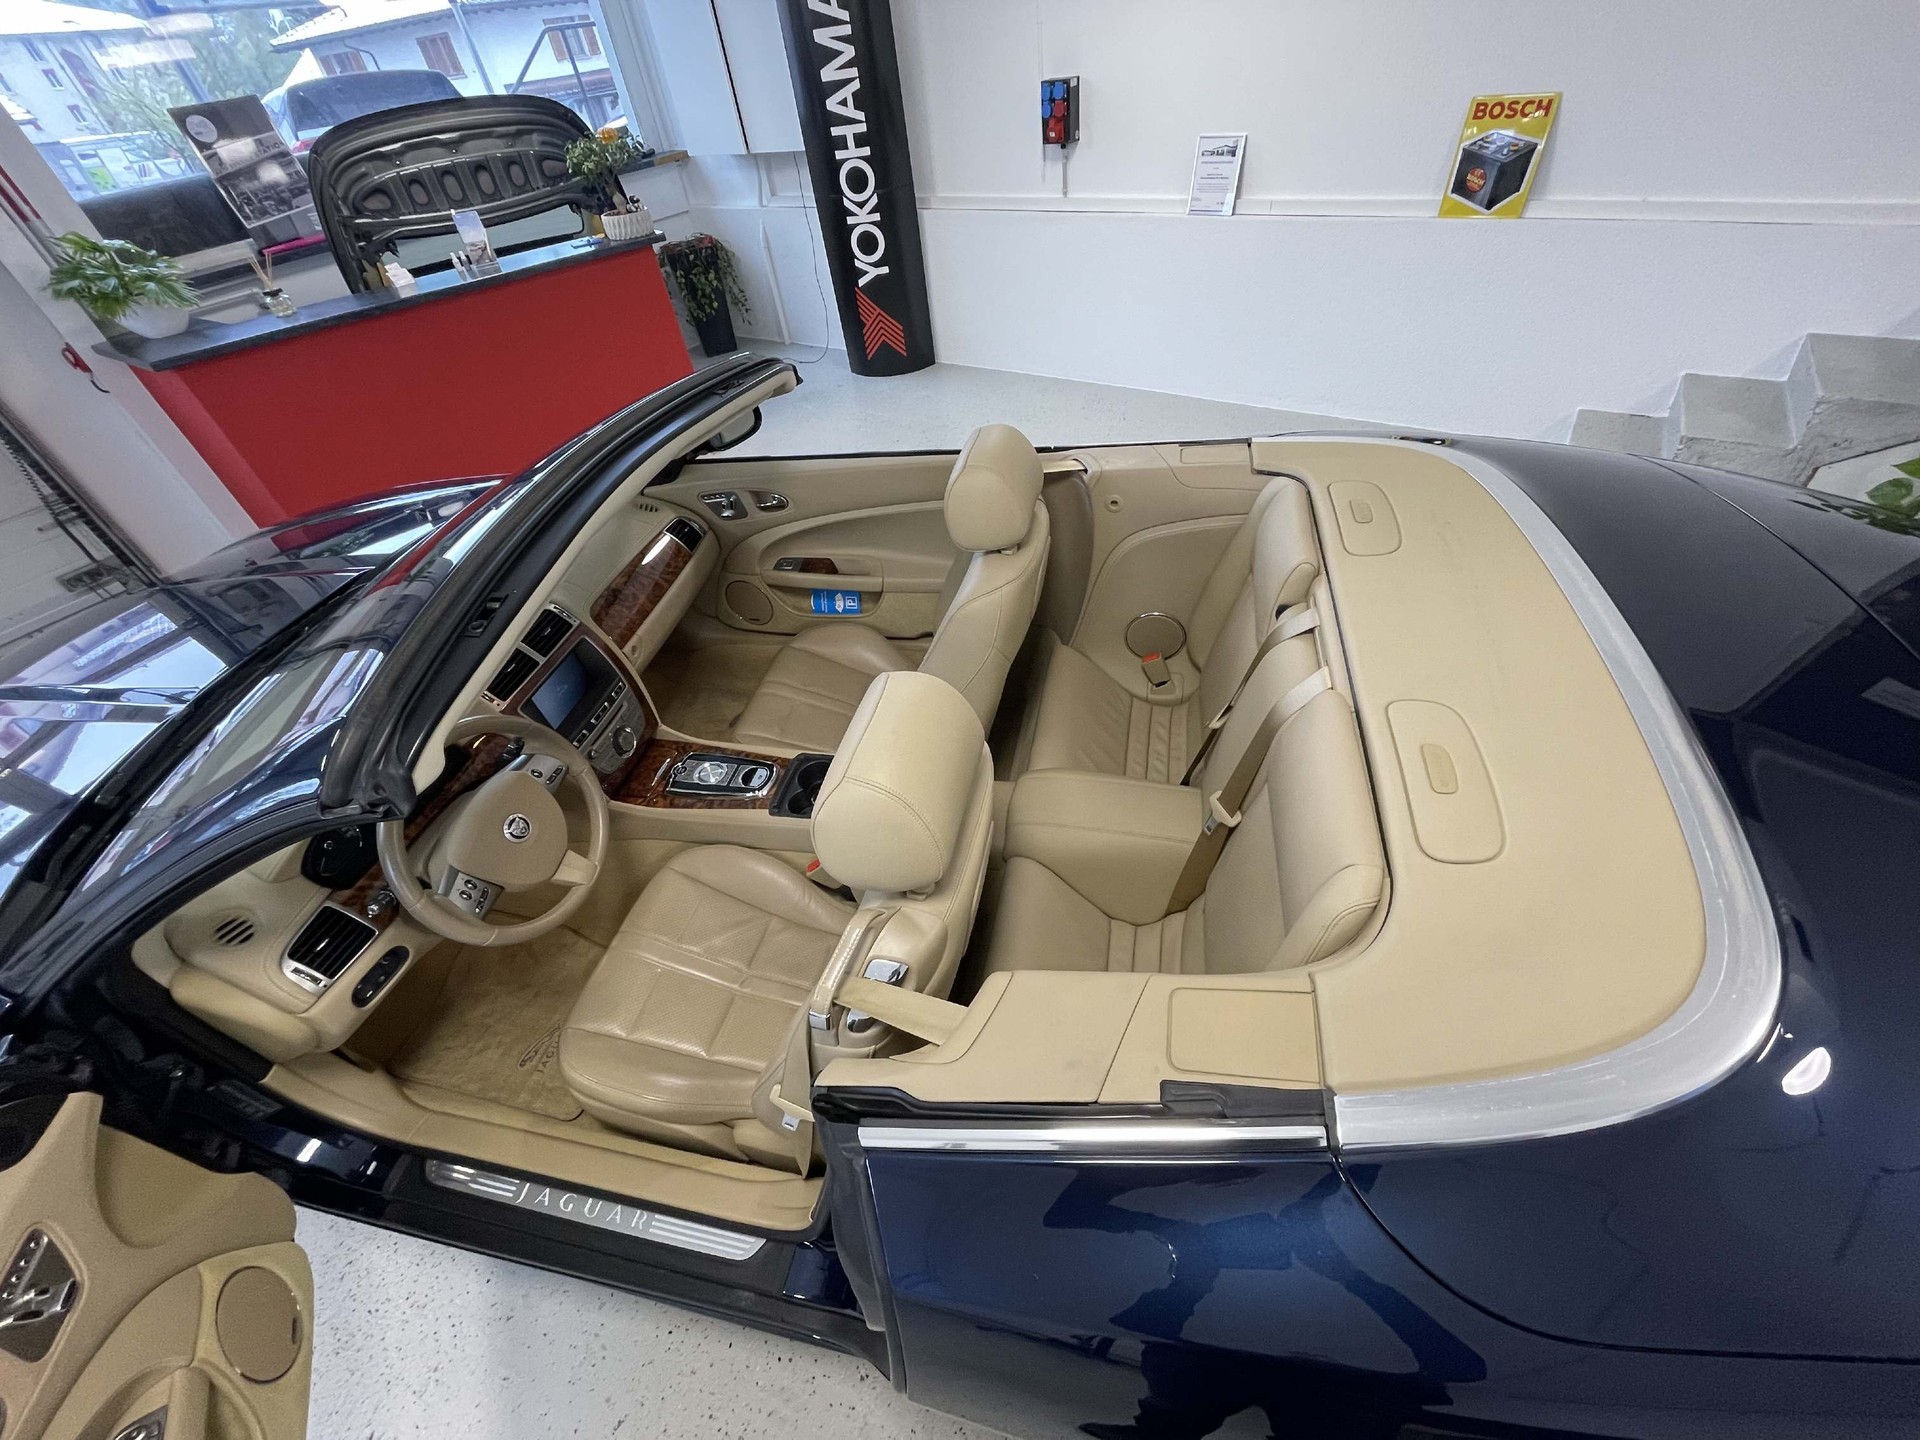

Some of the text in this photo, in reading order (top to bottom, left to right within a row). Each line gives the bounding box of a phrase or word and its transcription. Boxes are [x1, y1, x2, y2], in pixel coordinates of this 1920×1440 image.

[1472, 98, 1553, 120] BOSCH
[807, 0, 889, 287] YOKOHAMA
[515, 1182, 648, 1230] JAGUAR
